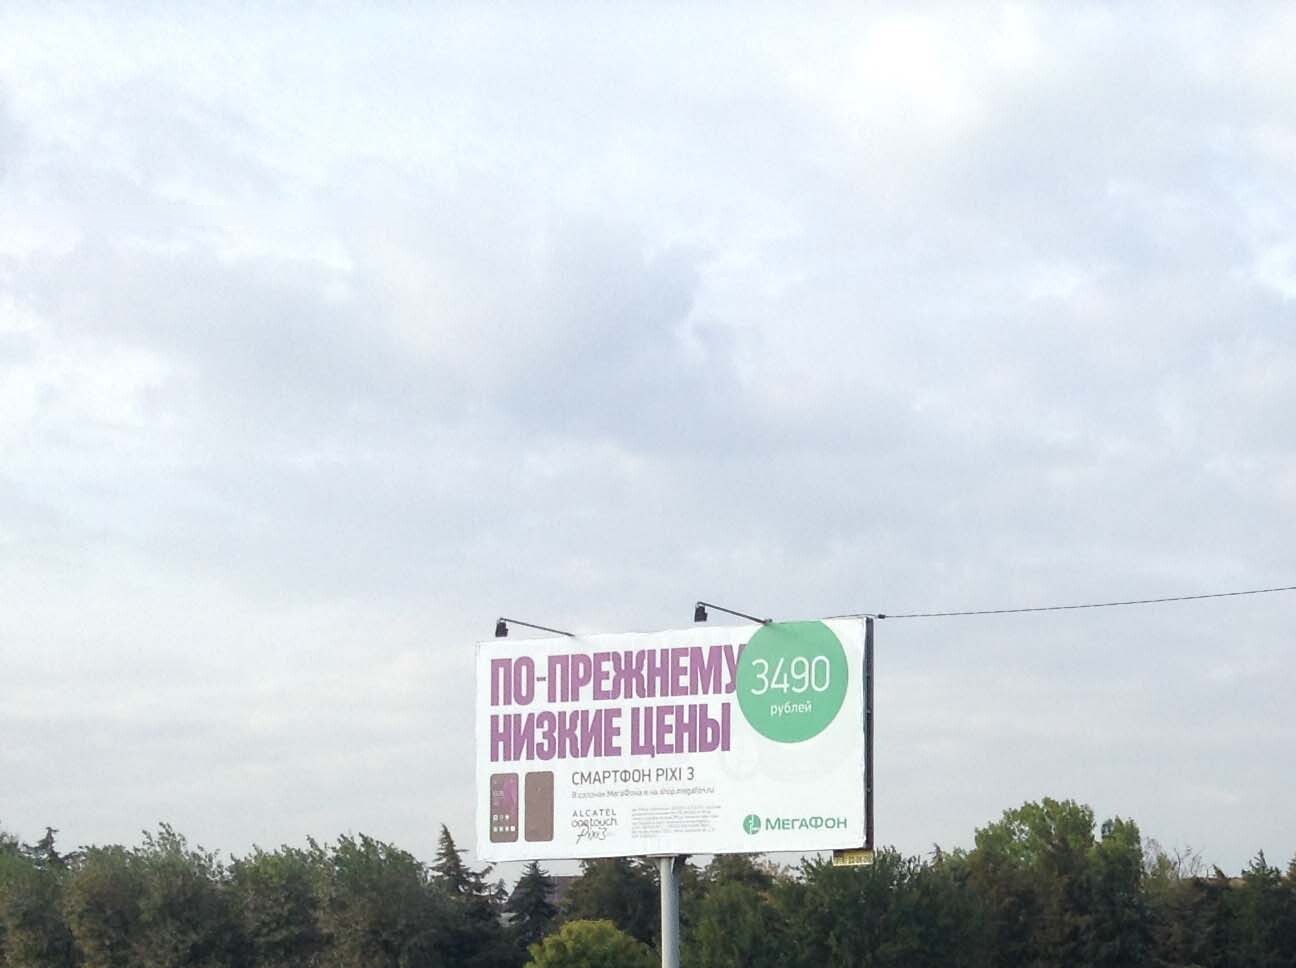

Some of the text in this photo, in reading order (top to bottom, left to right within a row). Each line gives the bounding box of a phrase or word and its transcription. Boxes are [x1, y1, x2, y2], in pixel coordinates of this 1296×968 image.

[490, 643, 748, 706] ПО-ПРЕЖНЕМУ
[751, 656, 831, 695] 3490
[770, 700, 813, 717] рублей
[490, 702, 732, 763] НИЗКИЕ ЦЕНЫ
[571, 766, 695, 786] СМАРТФОН PIXI 3
[572, 808, 617, 818] ALCATEL
